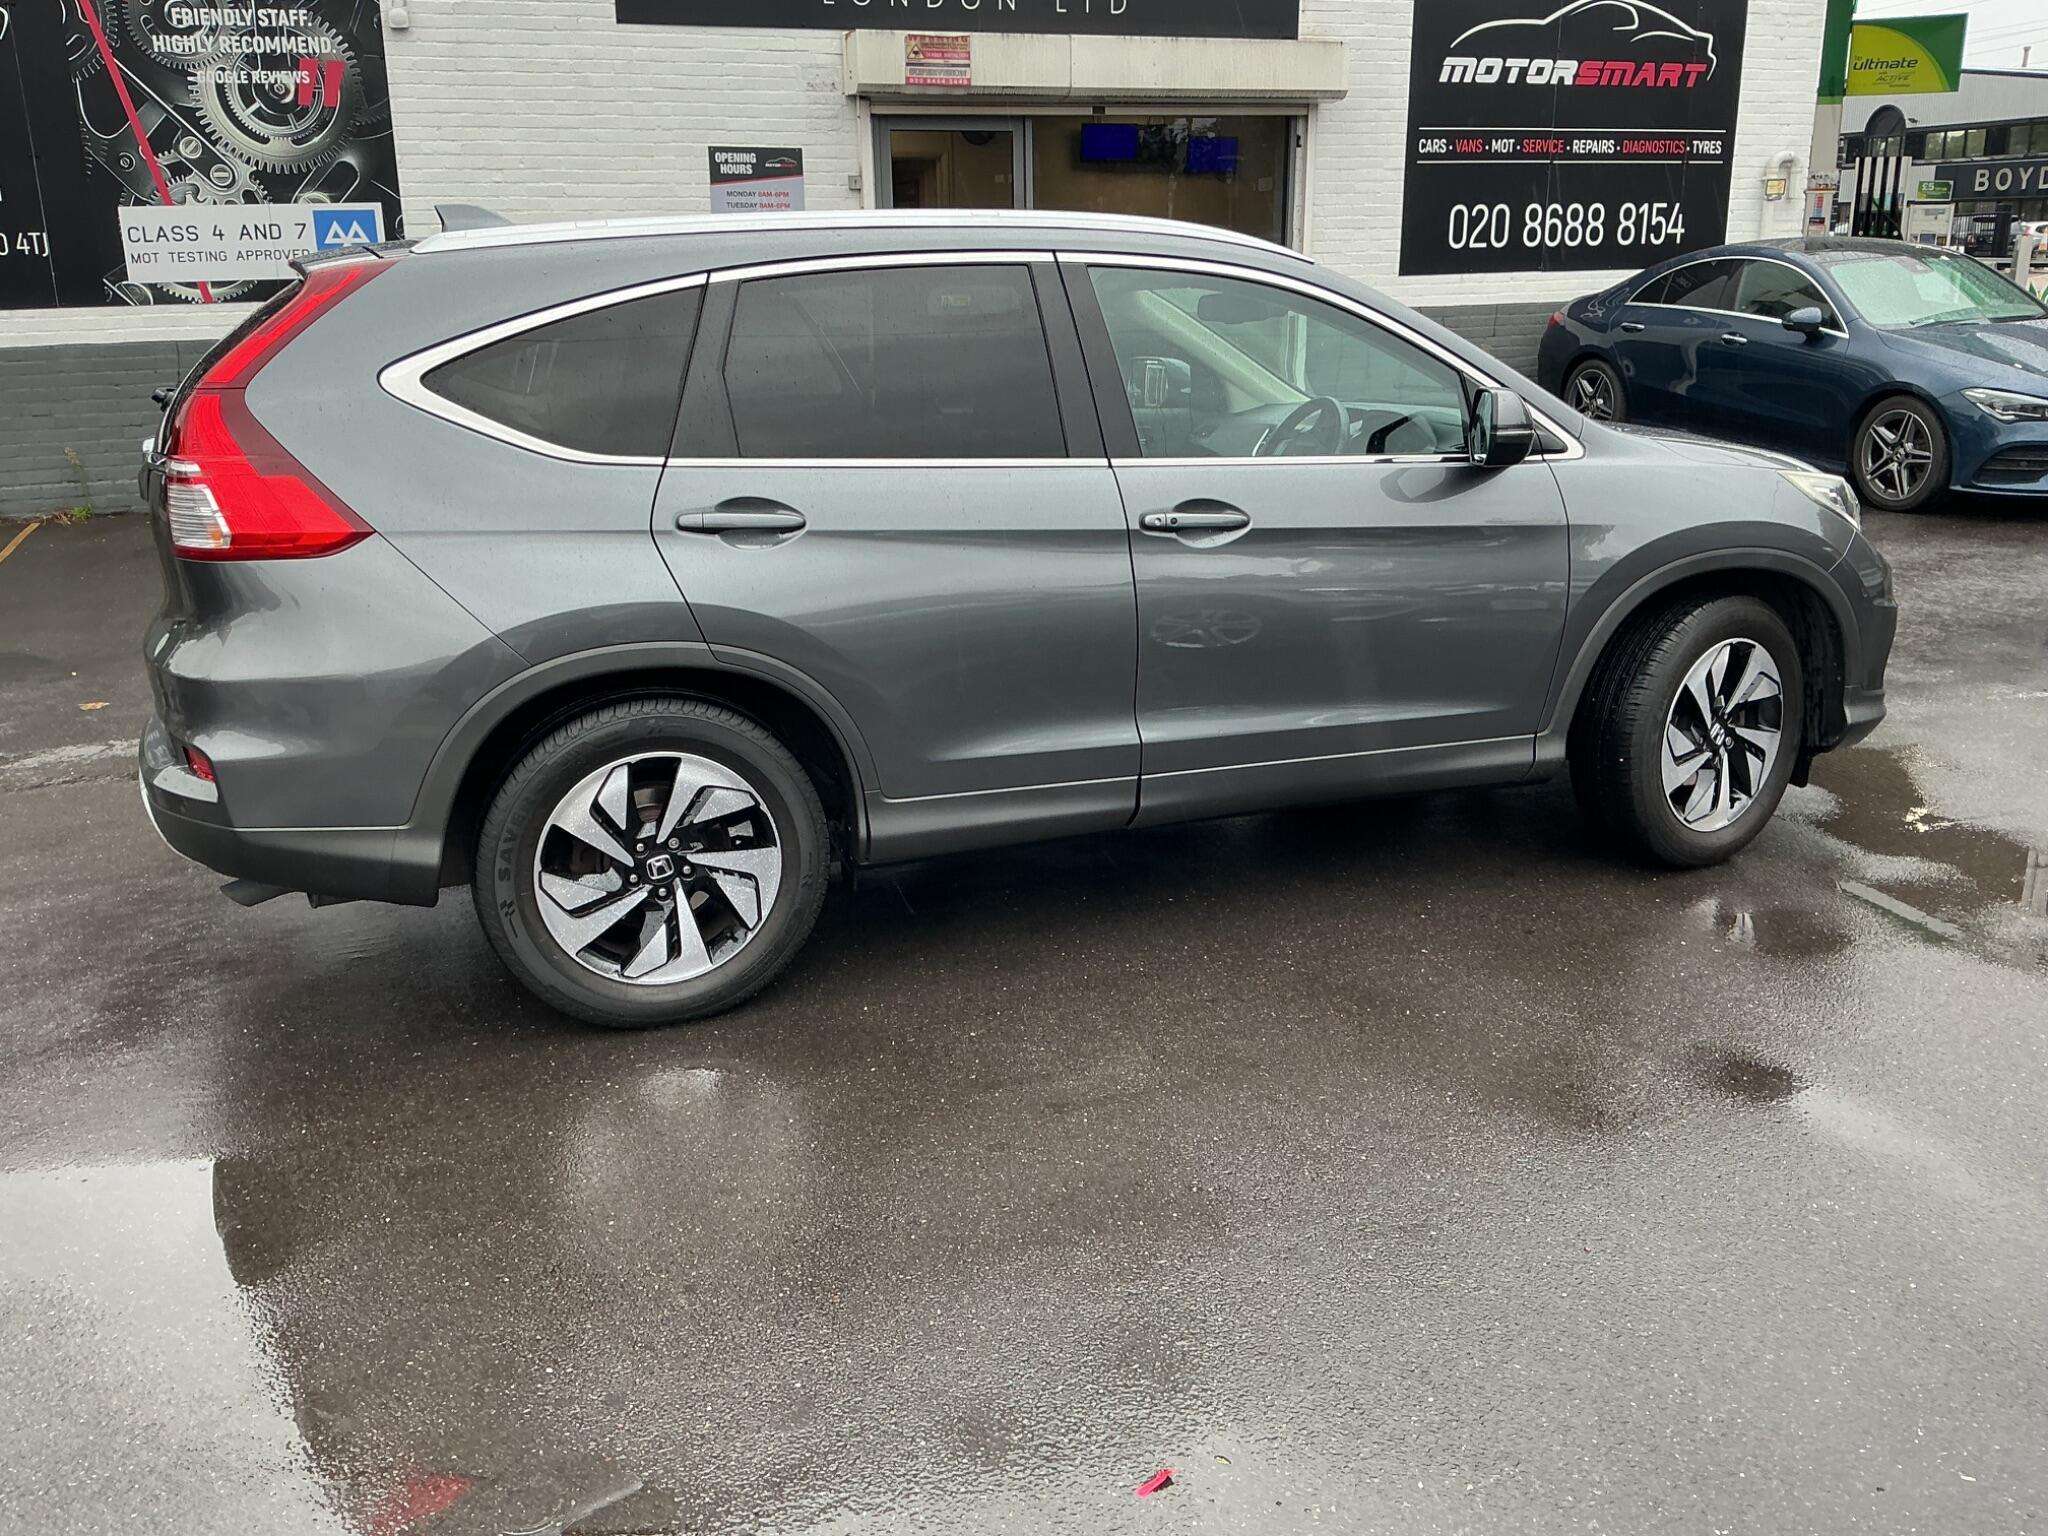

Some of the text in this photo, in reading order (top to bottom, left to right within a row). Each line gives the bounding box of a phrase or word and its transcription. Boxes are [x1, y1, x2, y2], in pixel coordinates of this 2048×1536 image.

[171, 8, 312, 27] FRIENDLY STAFF.
[151, 35, 336, 54] HIGHLY RECOMMEND.
[1853, 56, 1918, 71] ultimate
[198, 70, 311, 84] GOOGLE REVIEWS
[1439, 57, 1708, 88] MOTORSMART
[1418, 139, 1722, 155] CARS VANS MOT SERVICE REPAIRS DIAGNOSTICS TYRES
[714, 151, 757, 164] OPENING
[720, 163, 753, 175] HOURS
[726, 190, 757, 198] MONDAY
[127, 223, 307, 244] CLASS 4 AND 7
[1448, 202, 1685, 250] 020 8688 8154
[16, 232, 49, 257] 4TJ
[130, 250, 161, 265] MOT
[168, 250, 230, 264] TESTING
